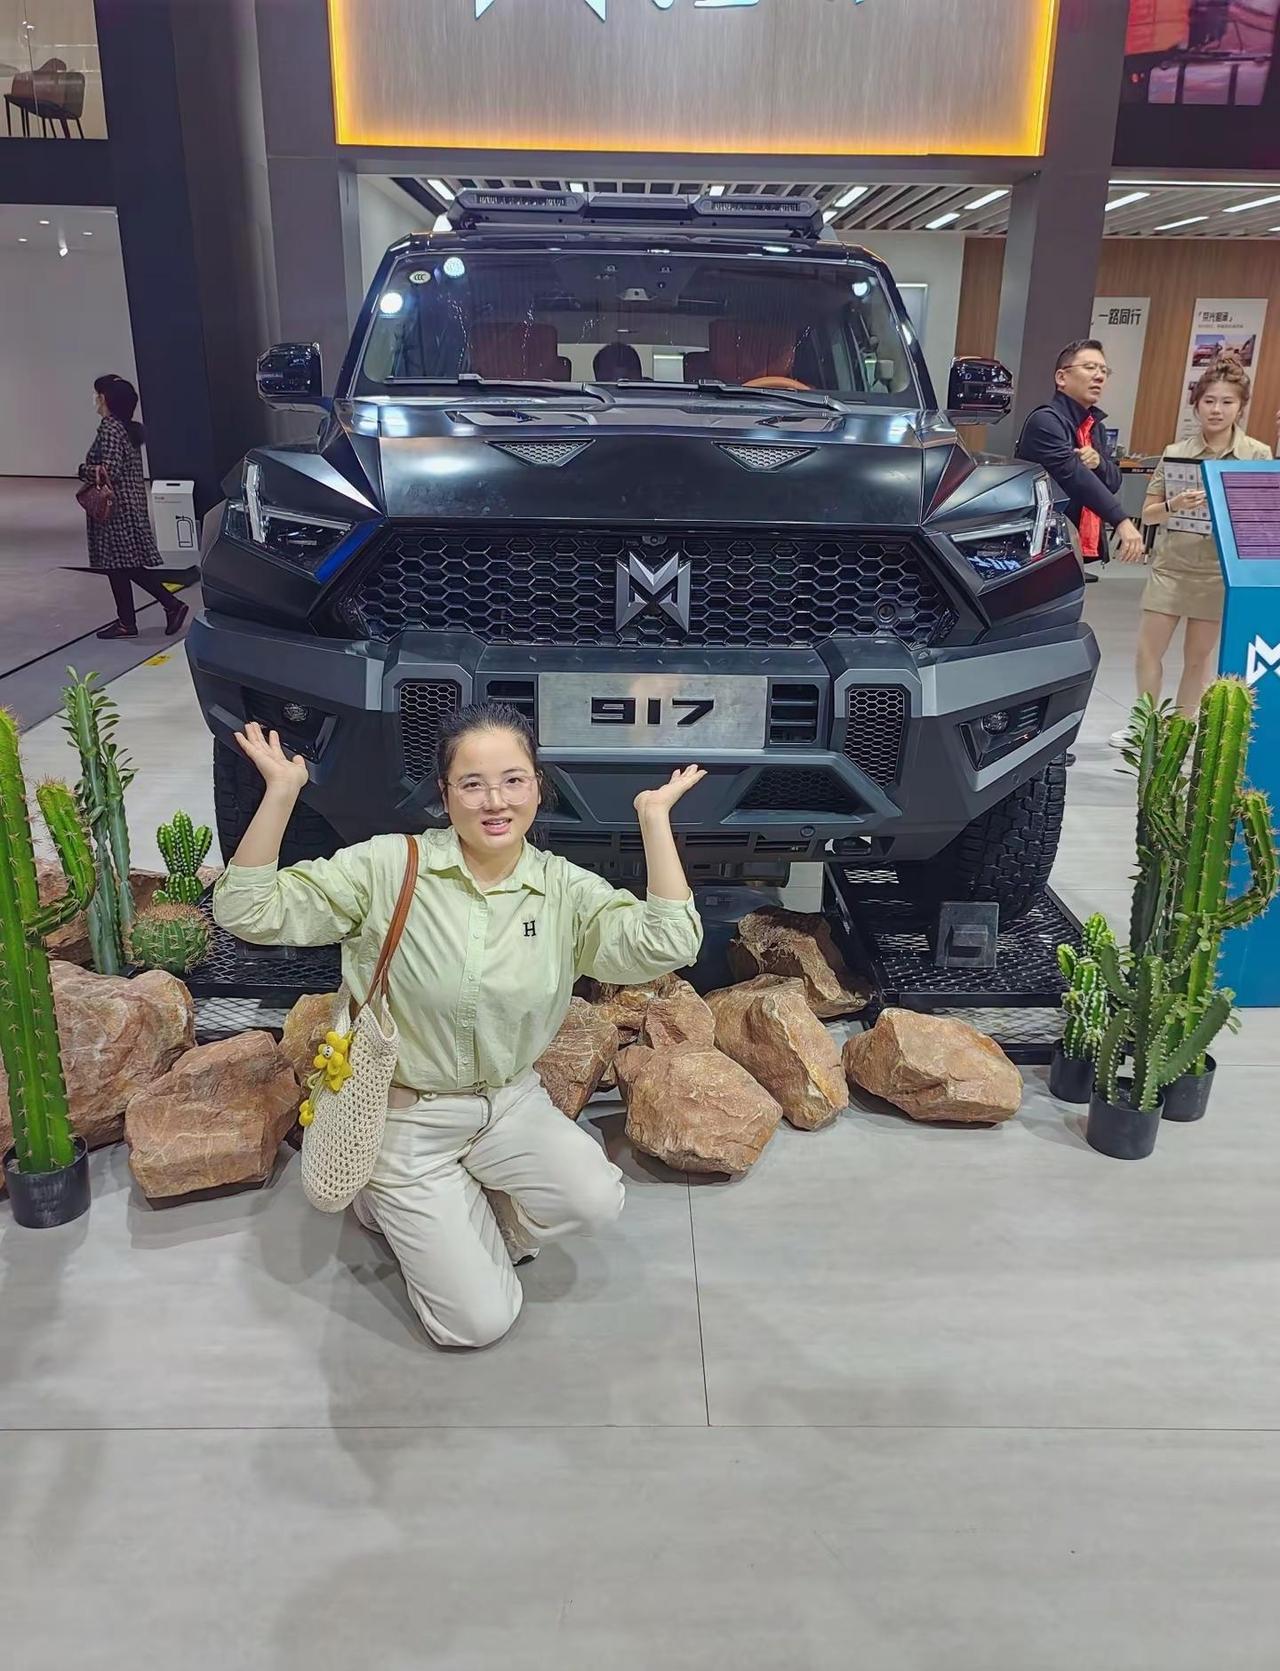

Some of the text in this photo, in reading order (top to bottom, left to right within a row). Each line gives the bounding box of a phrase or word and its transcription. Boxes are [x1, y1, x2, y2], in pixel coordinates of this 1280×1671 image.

[1098, 308, 1142, 325] 一路同行
[591, 697, 715, 725] 917
[523, 920, 536, 937] H
